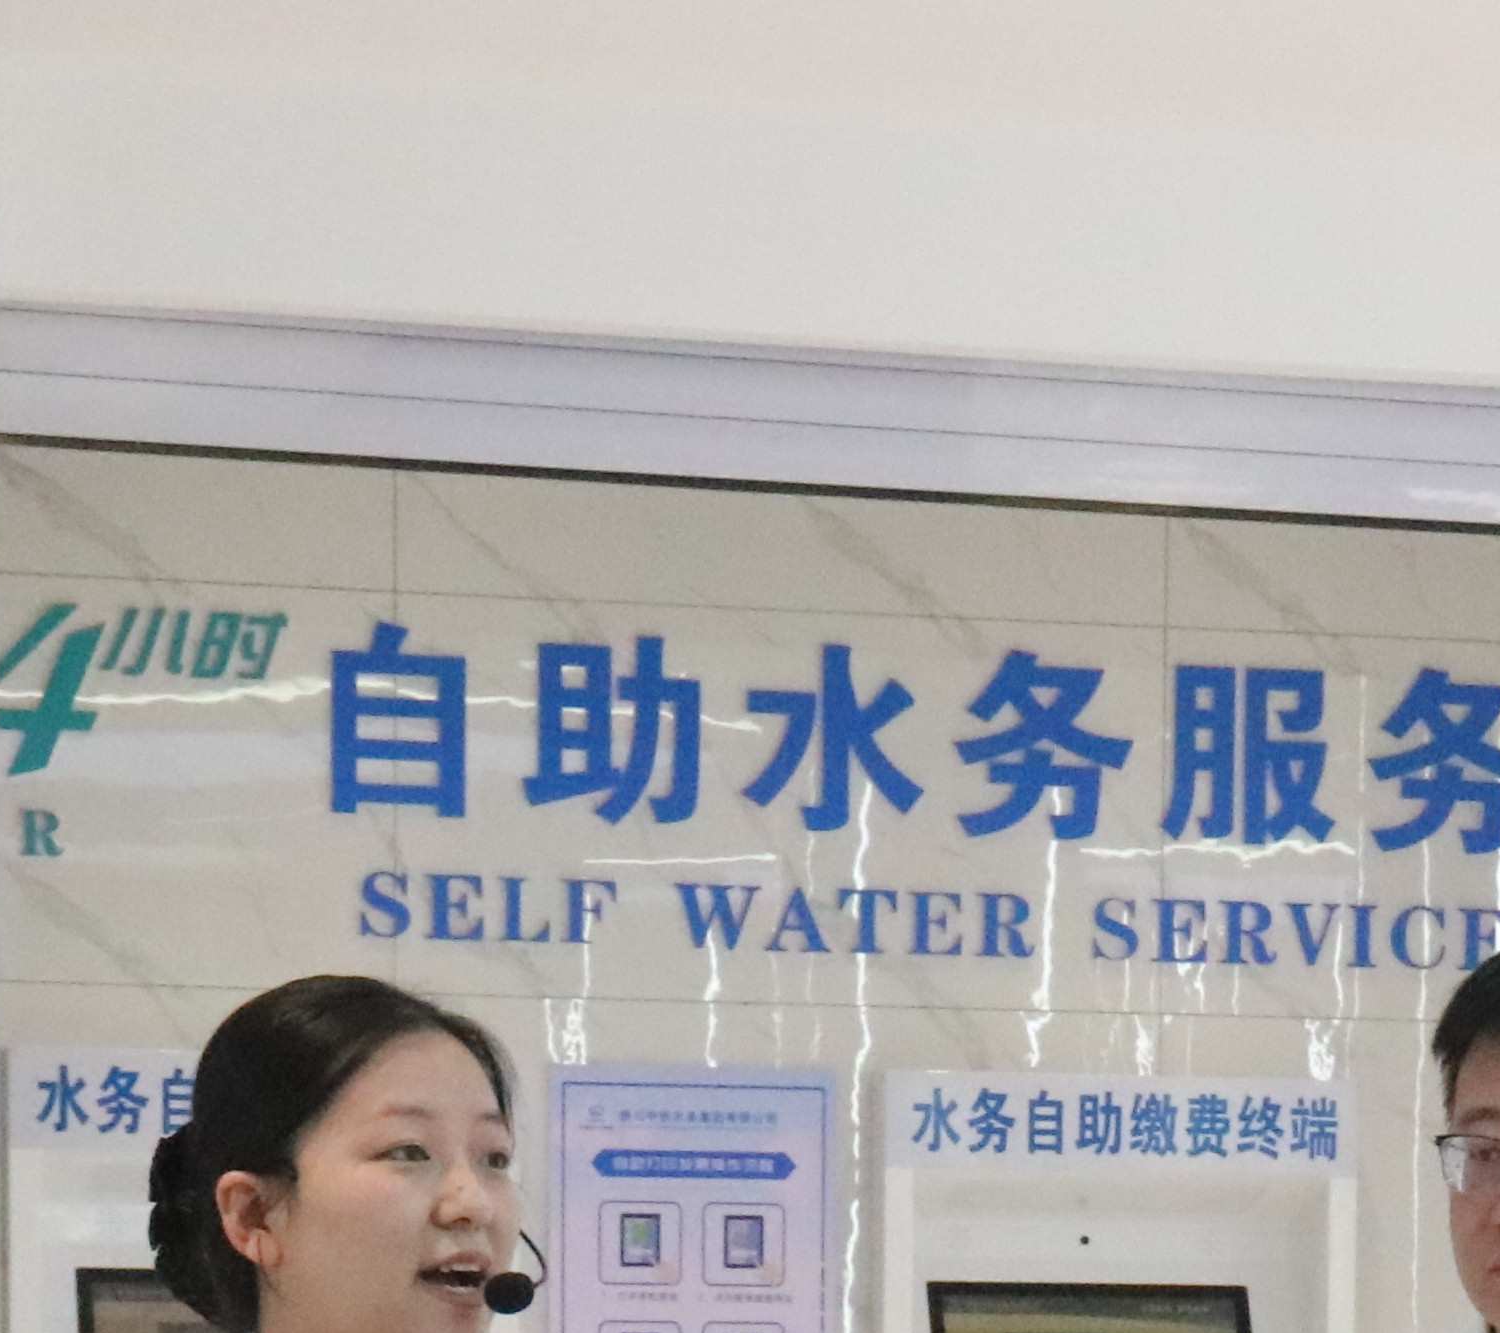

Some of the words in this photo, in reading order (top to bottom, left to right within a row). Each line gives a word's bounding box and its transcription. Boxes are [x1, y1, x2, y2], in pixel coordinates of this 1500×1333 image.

[359, 871, 618, 944] SELF
[675, 881, 1035, 959] WATER
[36, 1064, 197, 1134] 水务自
[912, 1088, 1339, 1160] 水务自助缴费终端
